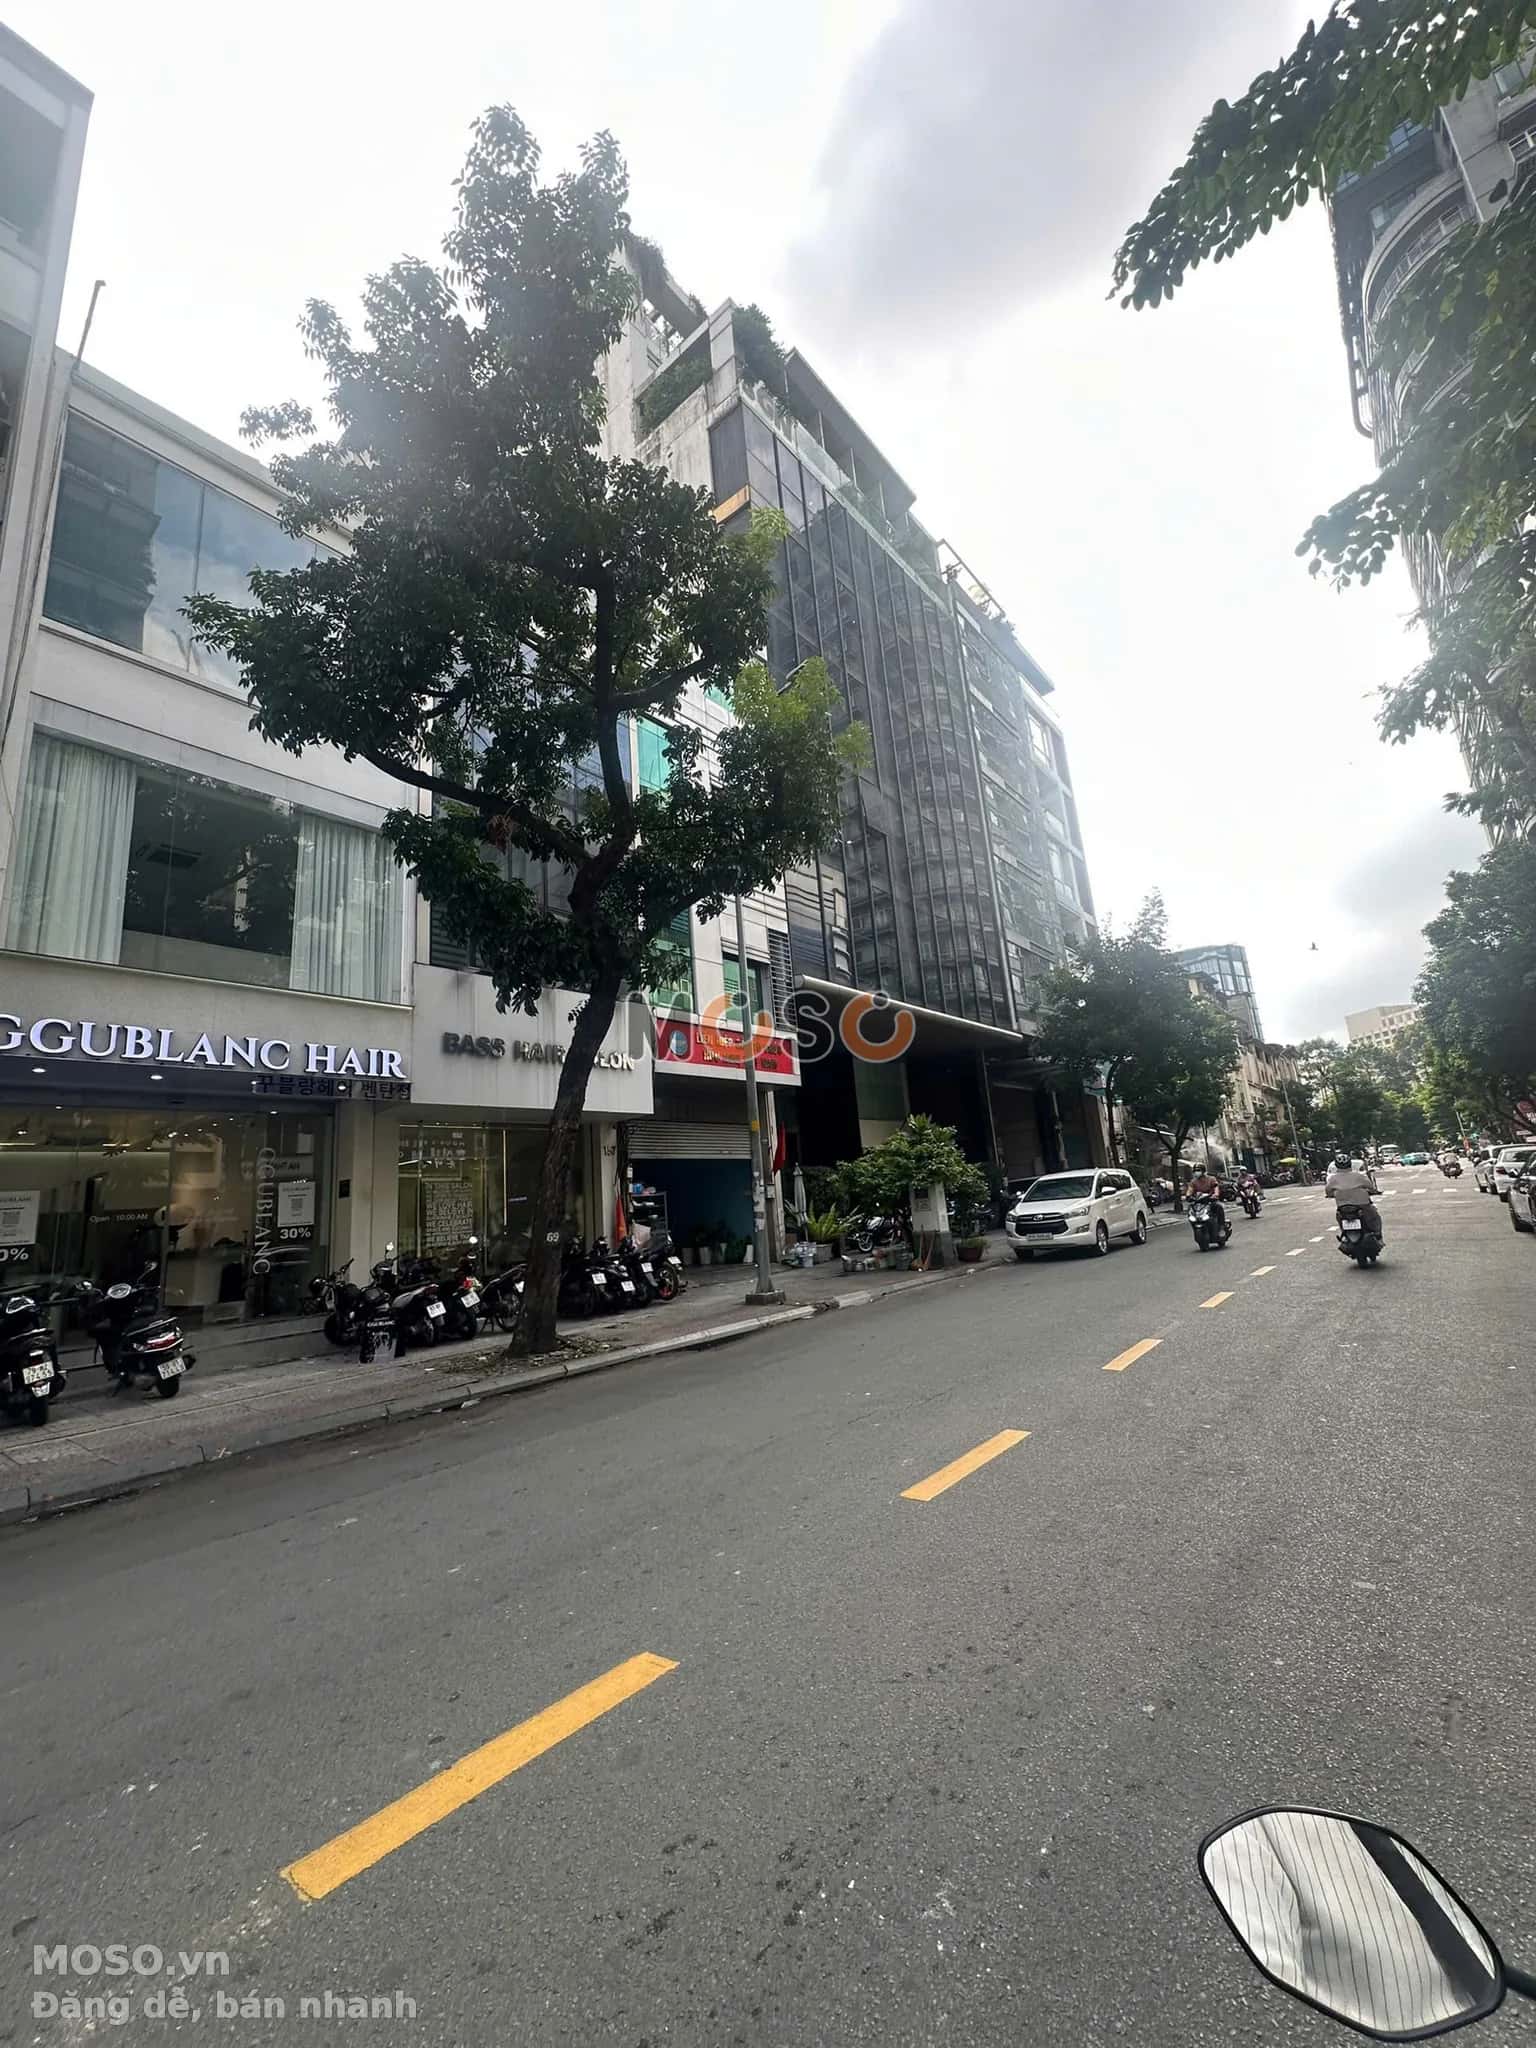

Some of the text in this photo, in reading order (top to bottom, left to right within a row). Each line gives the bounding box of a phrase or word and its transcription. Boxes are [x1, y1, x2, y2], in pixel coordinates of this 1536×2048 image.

[305, 1042, 408, 1079] HAIR
[442, 1032, 507, 1059] BASS
[512, 1040, 568, 1064] HAIR
[279, 1226, 311, 1240] 30%
